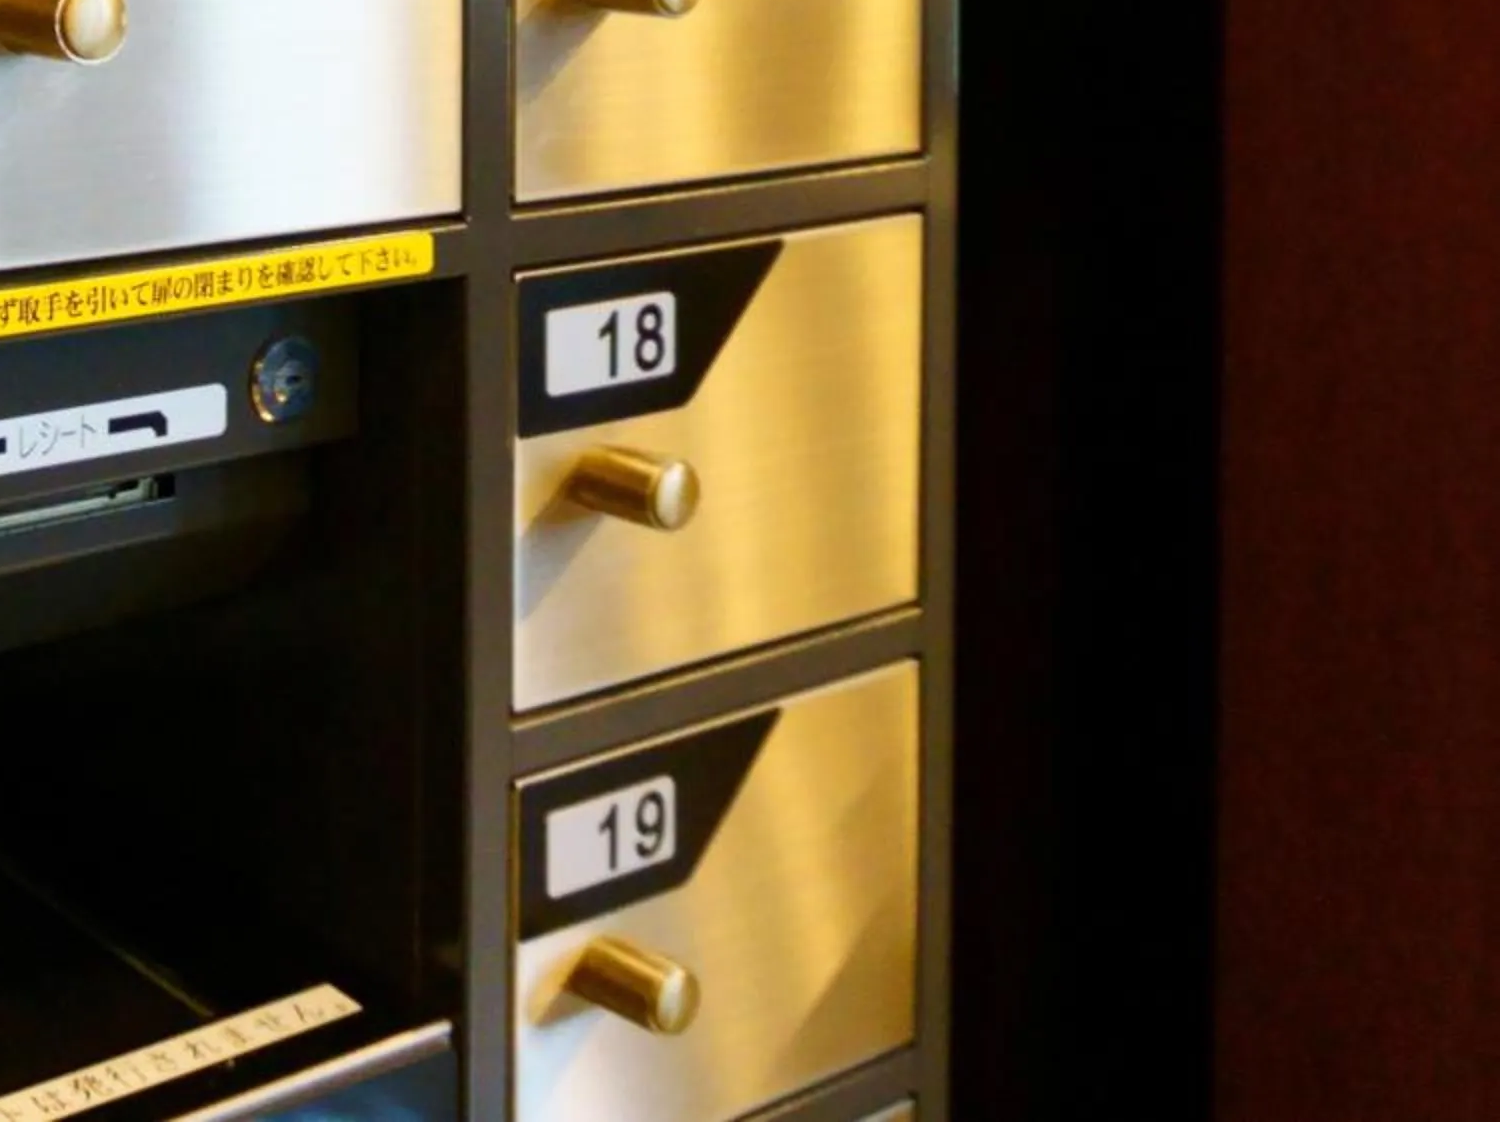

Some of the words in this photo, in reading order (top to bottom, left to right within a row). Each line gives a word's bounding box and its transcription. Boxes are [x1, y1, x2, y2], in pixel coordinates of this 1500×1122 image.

[599, 303, 665, 379] 18
[17, 413, 98, 458] レシート
[599, 791, 665, 871] 19
